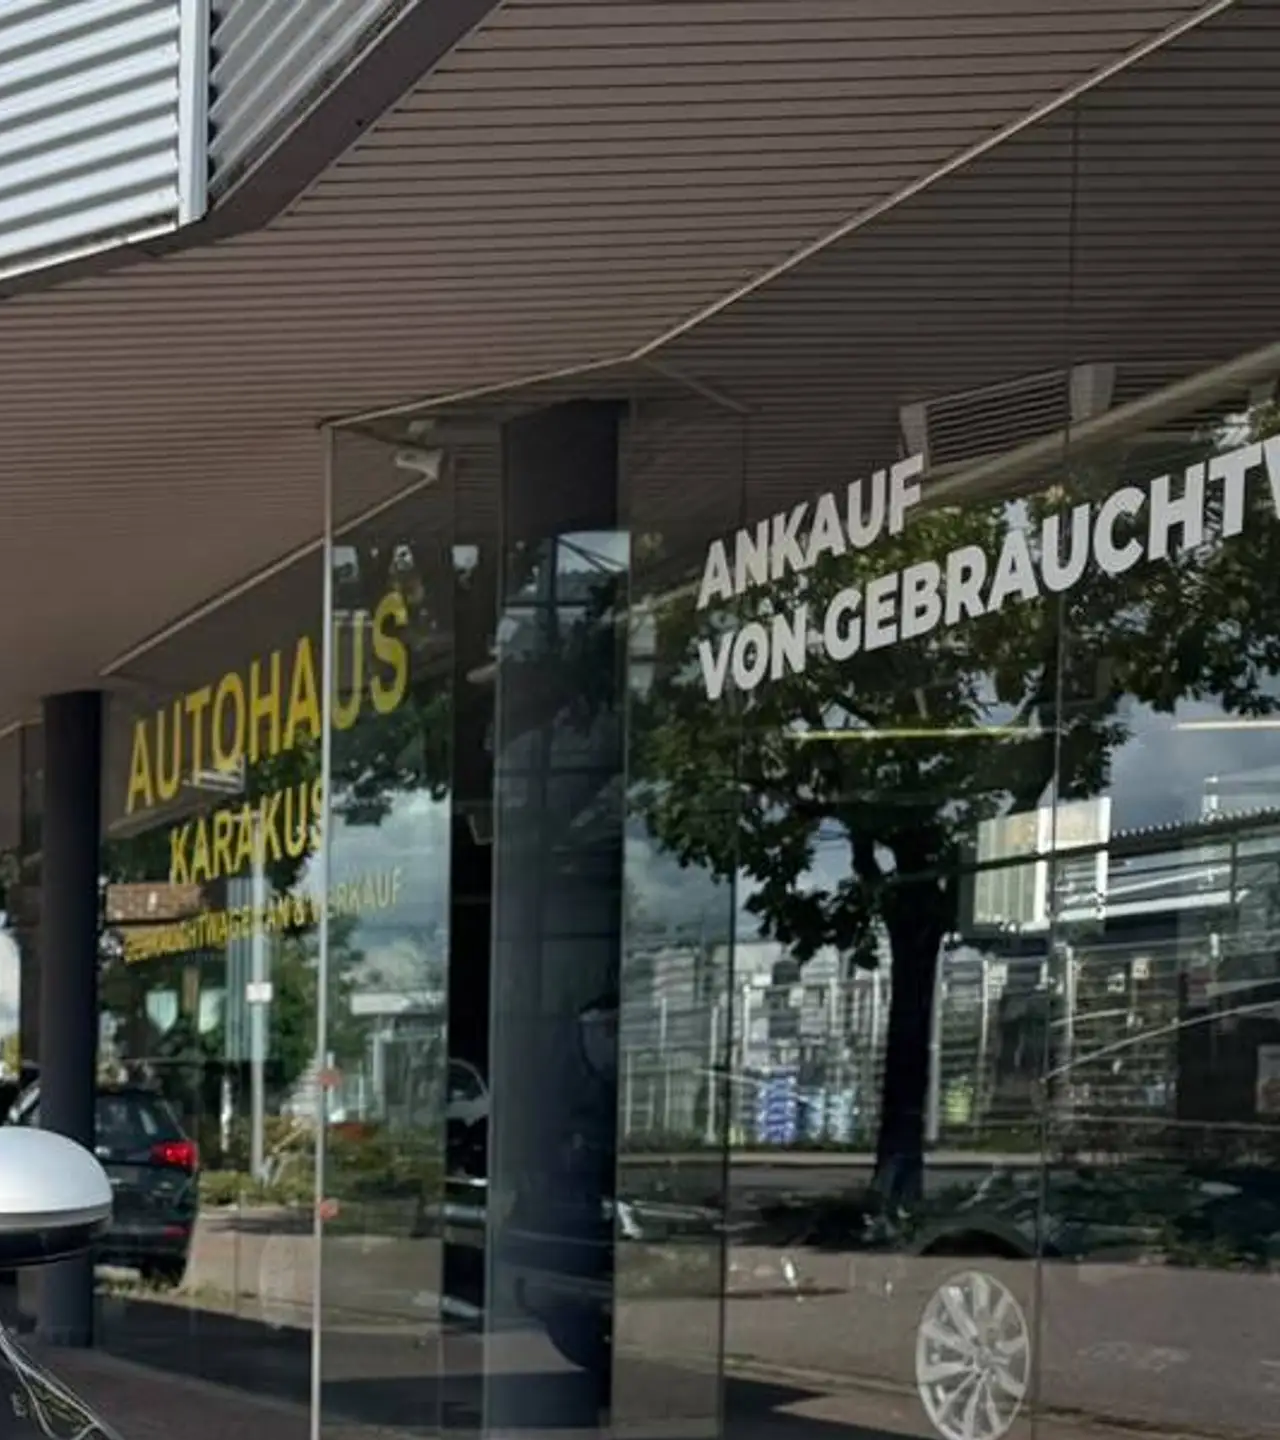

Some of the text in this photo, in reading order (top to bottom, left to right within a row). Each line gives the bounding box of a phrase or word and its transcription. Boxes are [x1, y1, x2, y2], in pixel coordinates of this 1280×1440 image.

[698, 454, 923, 608] ANKAUF
[127, 592, 408, 814] AUTOHAUS
[699, 605, 806, 699] VON
[170, 778, 323, 886] KARAKUS
